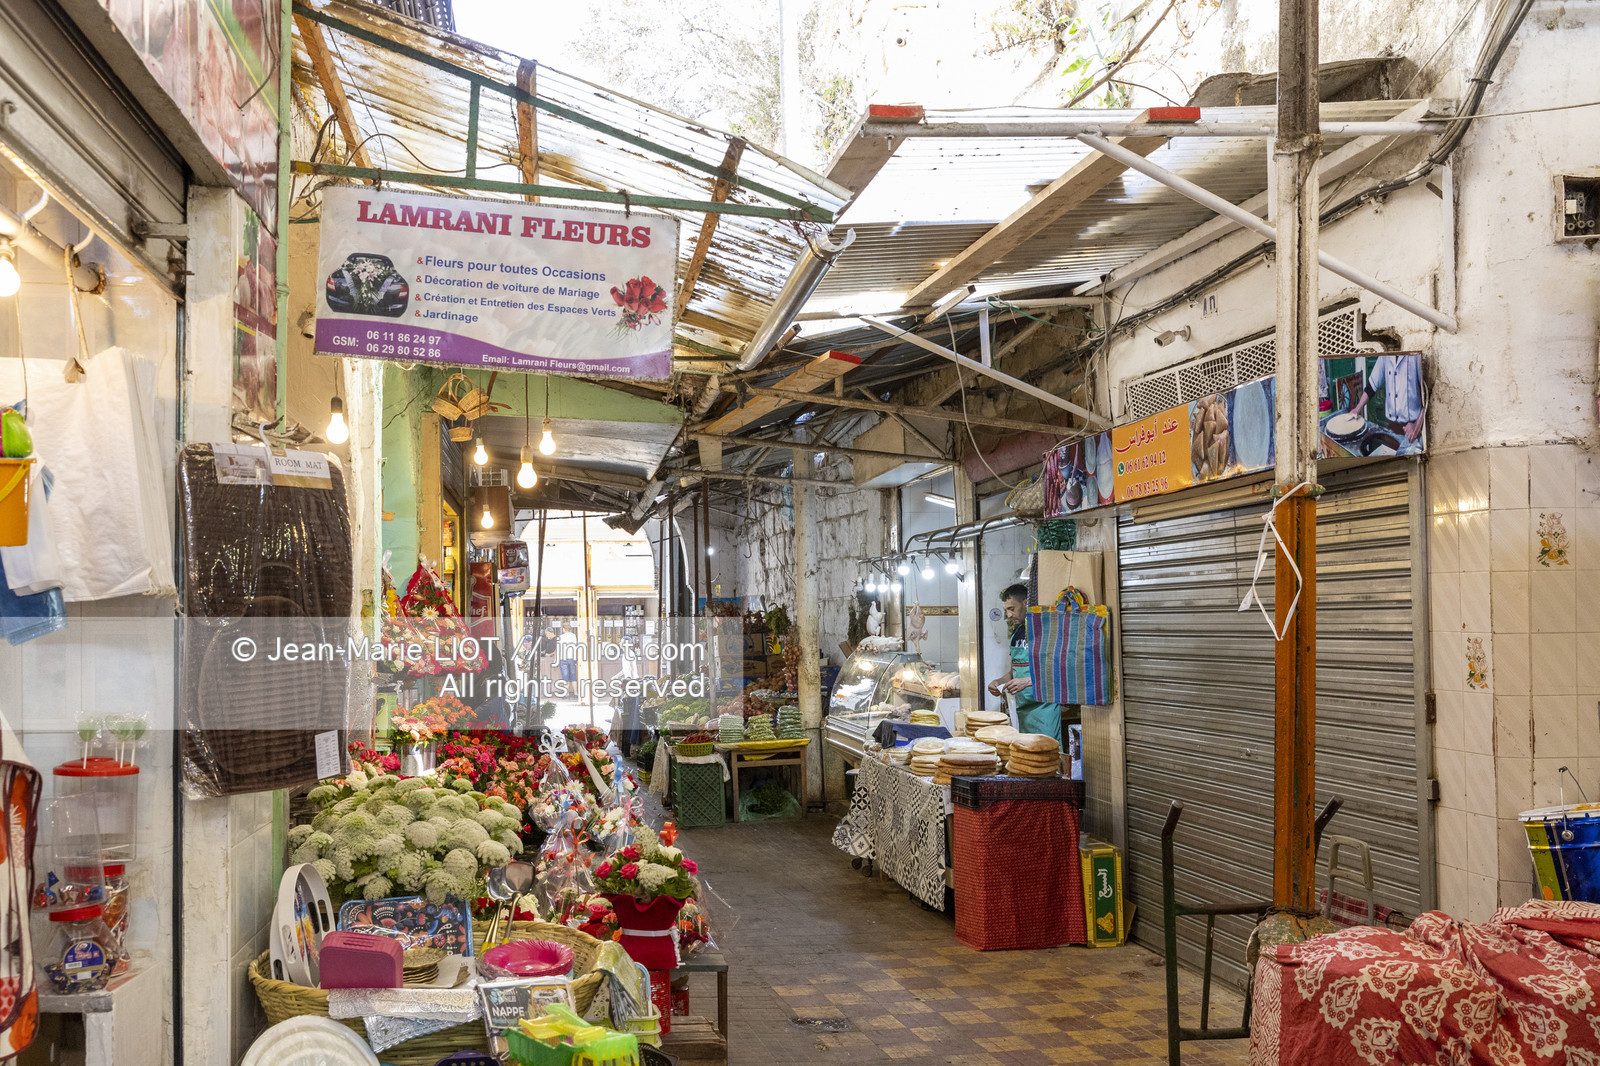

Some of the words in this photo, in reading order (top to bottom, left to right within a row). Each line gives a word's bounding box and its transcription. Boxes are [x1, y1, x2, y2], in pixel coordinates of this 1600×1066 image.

[357, 200, 512, 236] LAMRANI
[520, 216, 651, 248] FLEURS
[467, 262, 497, 272] pour
[500, 263, 538, 275] toutes
[542, 266, 606, 281] Occasions
[424, 275, 483, 288] Décoration
[486, 281, 499, 290] de
[502, 283, 539, 293] voiture
[542, 286, 555, 295] de
[558, 287, 600, 300] Mariage
[468, 297, 478, 305] et
[480, 297, 525, 309] Entretien
[527, 302, 545, 311] des
[547, 303, 588, 314] Espaces
[591, 307, 616, 317] Verts
[332, 335, 359, 347] GSM:
[366, 330, 379, 340] 06
[382, 332, 394, 341] 11
[397, 333, 410, 342] 86
[413, 334, 426, 344] 24
[428, 336, 441, 345] 97
[366, 343, 379, 352] 06
[382, 344, 395, 354] 29
[397, 346, 410, 355] 80
[413, 347, 426, 357] 52
[428, 348, 441, 358] 86
[482, 354, 509, 364] Email:
[512, 356, 547, 367] Lamrani
[550, 359, 630, 373] Fleurs@gmail.com
[1162, 418, 1178, 435] عند
[275, 457, 301, 468] ROOM
[305, 461, 322, 470] MAT
[1125, 460, 1132, 473] 06
[1133, 458, 1141, 471] 61
[1141, 455, 1149, 469] 62
[1150, 453, 1157, 467] 94
[1158, 450, 1167, 465] 12
[1126, 484, 1134, 498] 06
[1135, 482, 1142, 496] 78
[471, 606, 487, 617] hef
[492, 1006, 524, 1017] NAPPE
